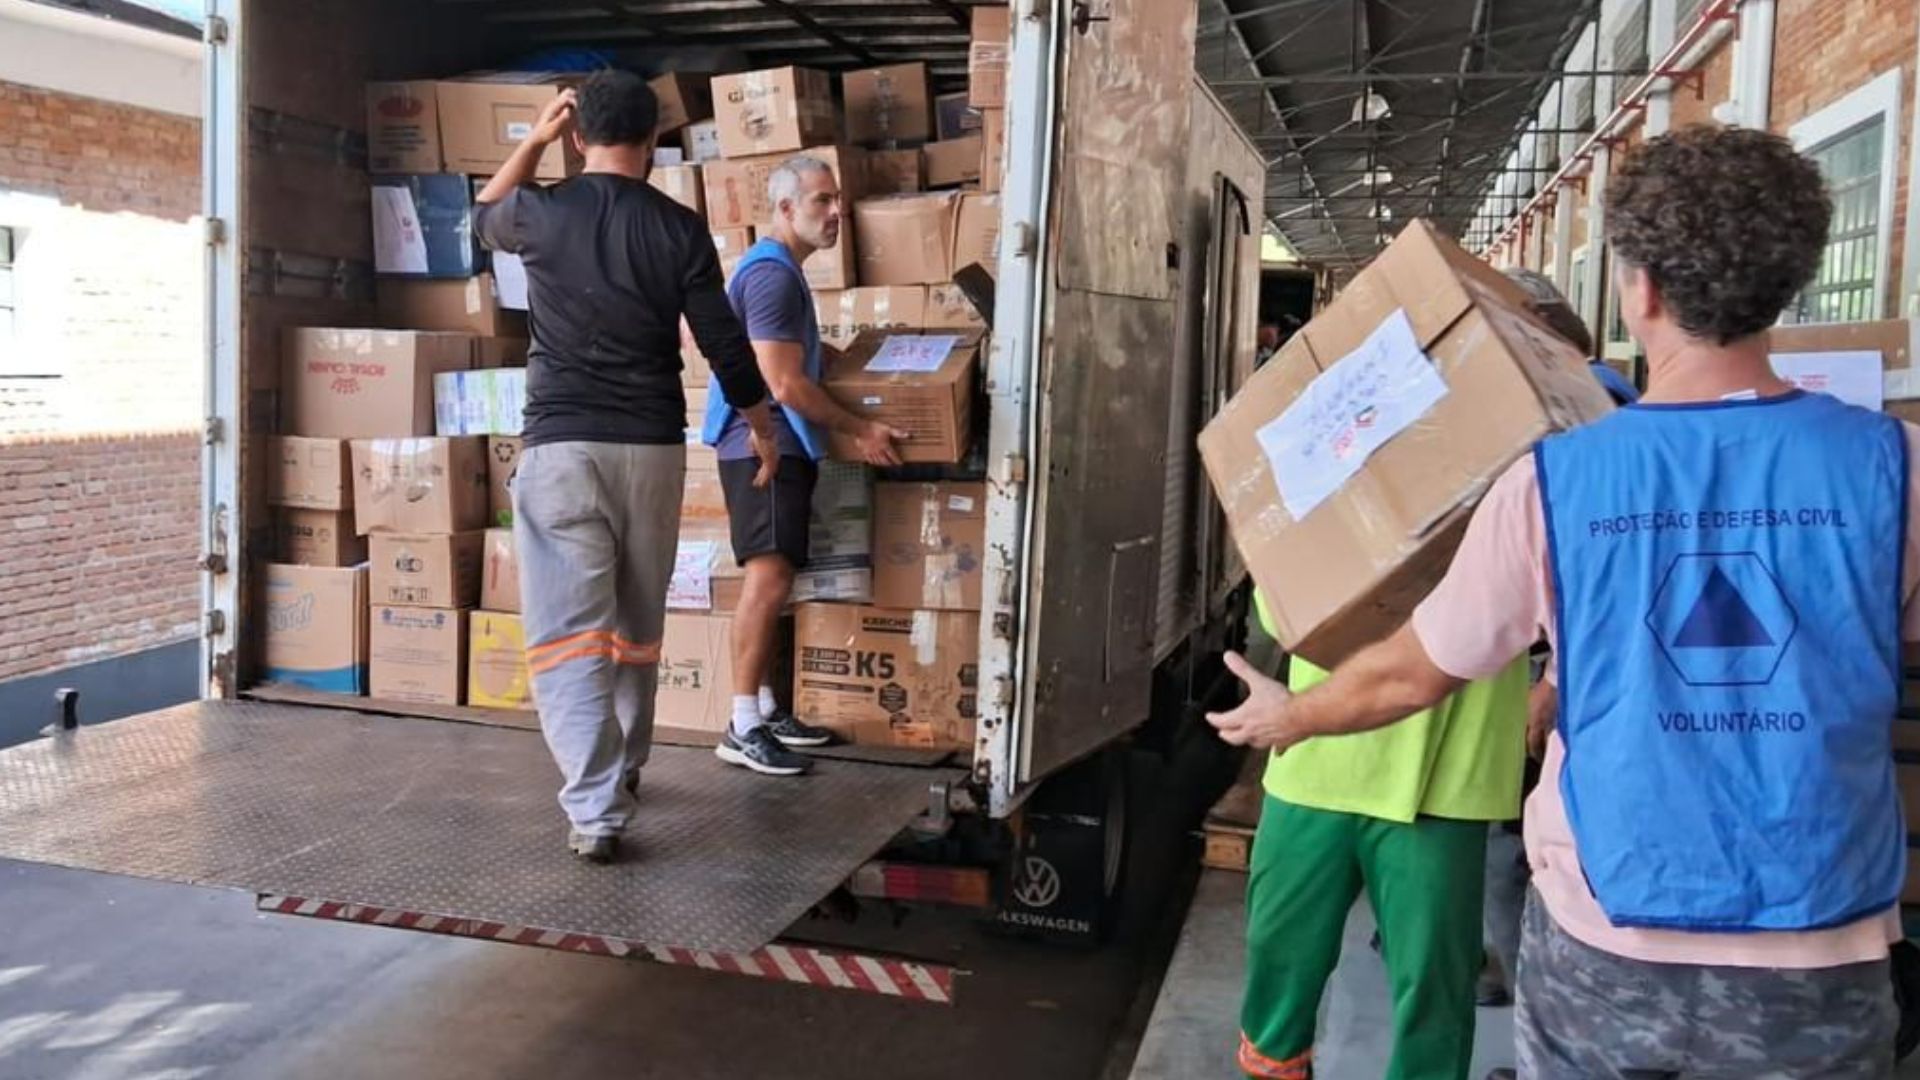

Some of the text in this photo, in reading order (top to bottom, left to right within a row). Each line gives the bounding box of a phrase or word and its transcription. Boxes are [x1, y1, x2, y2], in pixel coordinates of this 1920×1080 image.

[1588, 508, 1848, 538] PROTEÇÃO E DEFESA CIVIL
[855, 651, 895, 679] K5
[692, 669, 702, 689] 1
[1657, 707, 1806, 733] VOLUNTÁRIO
[998, 910, 1090, 933] LKSWAGEN
